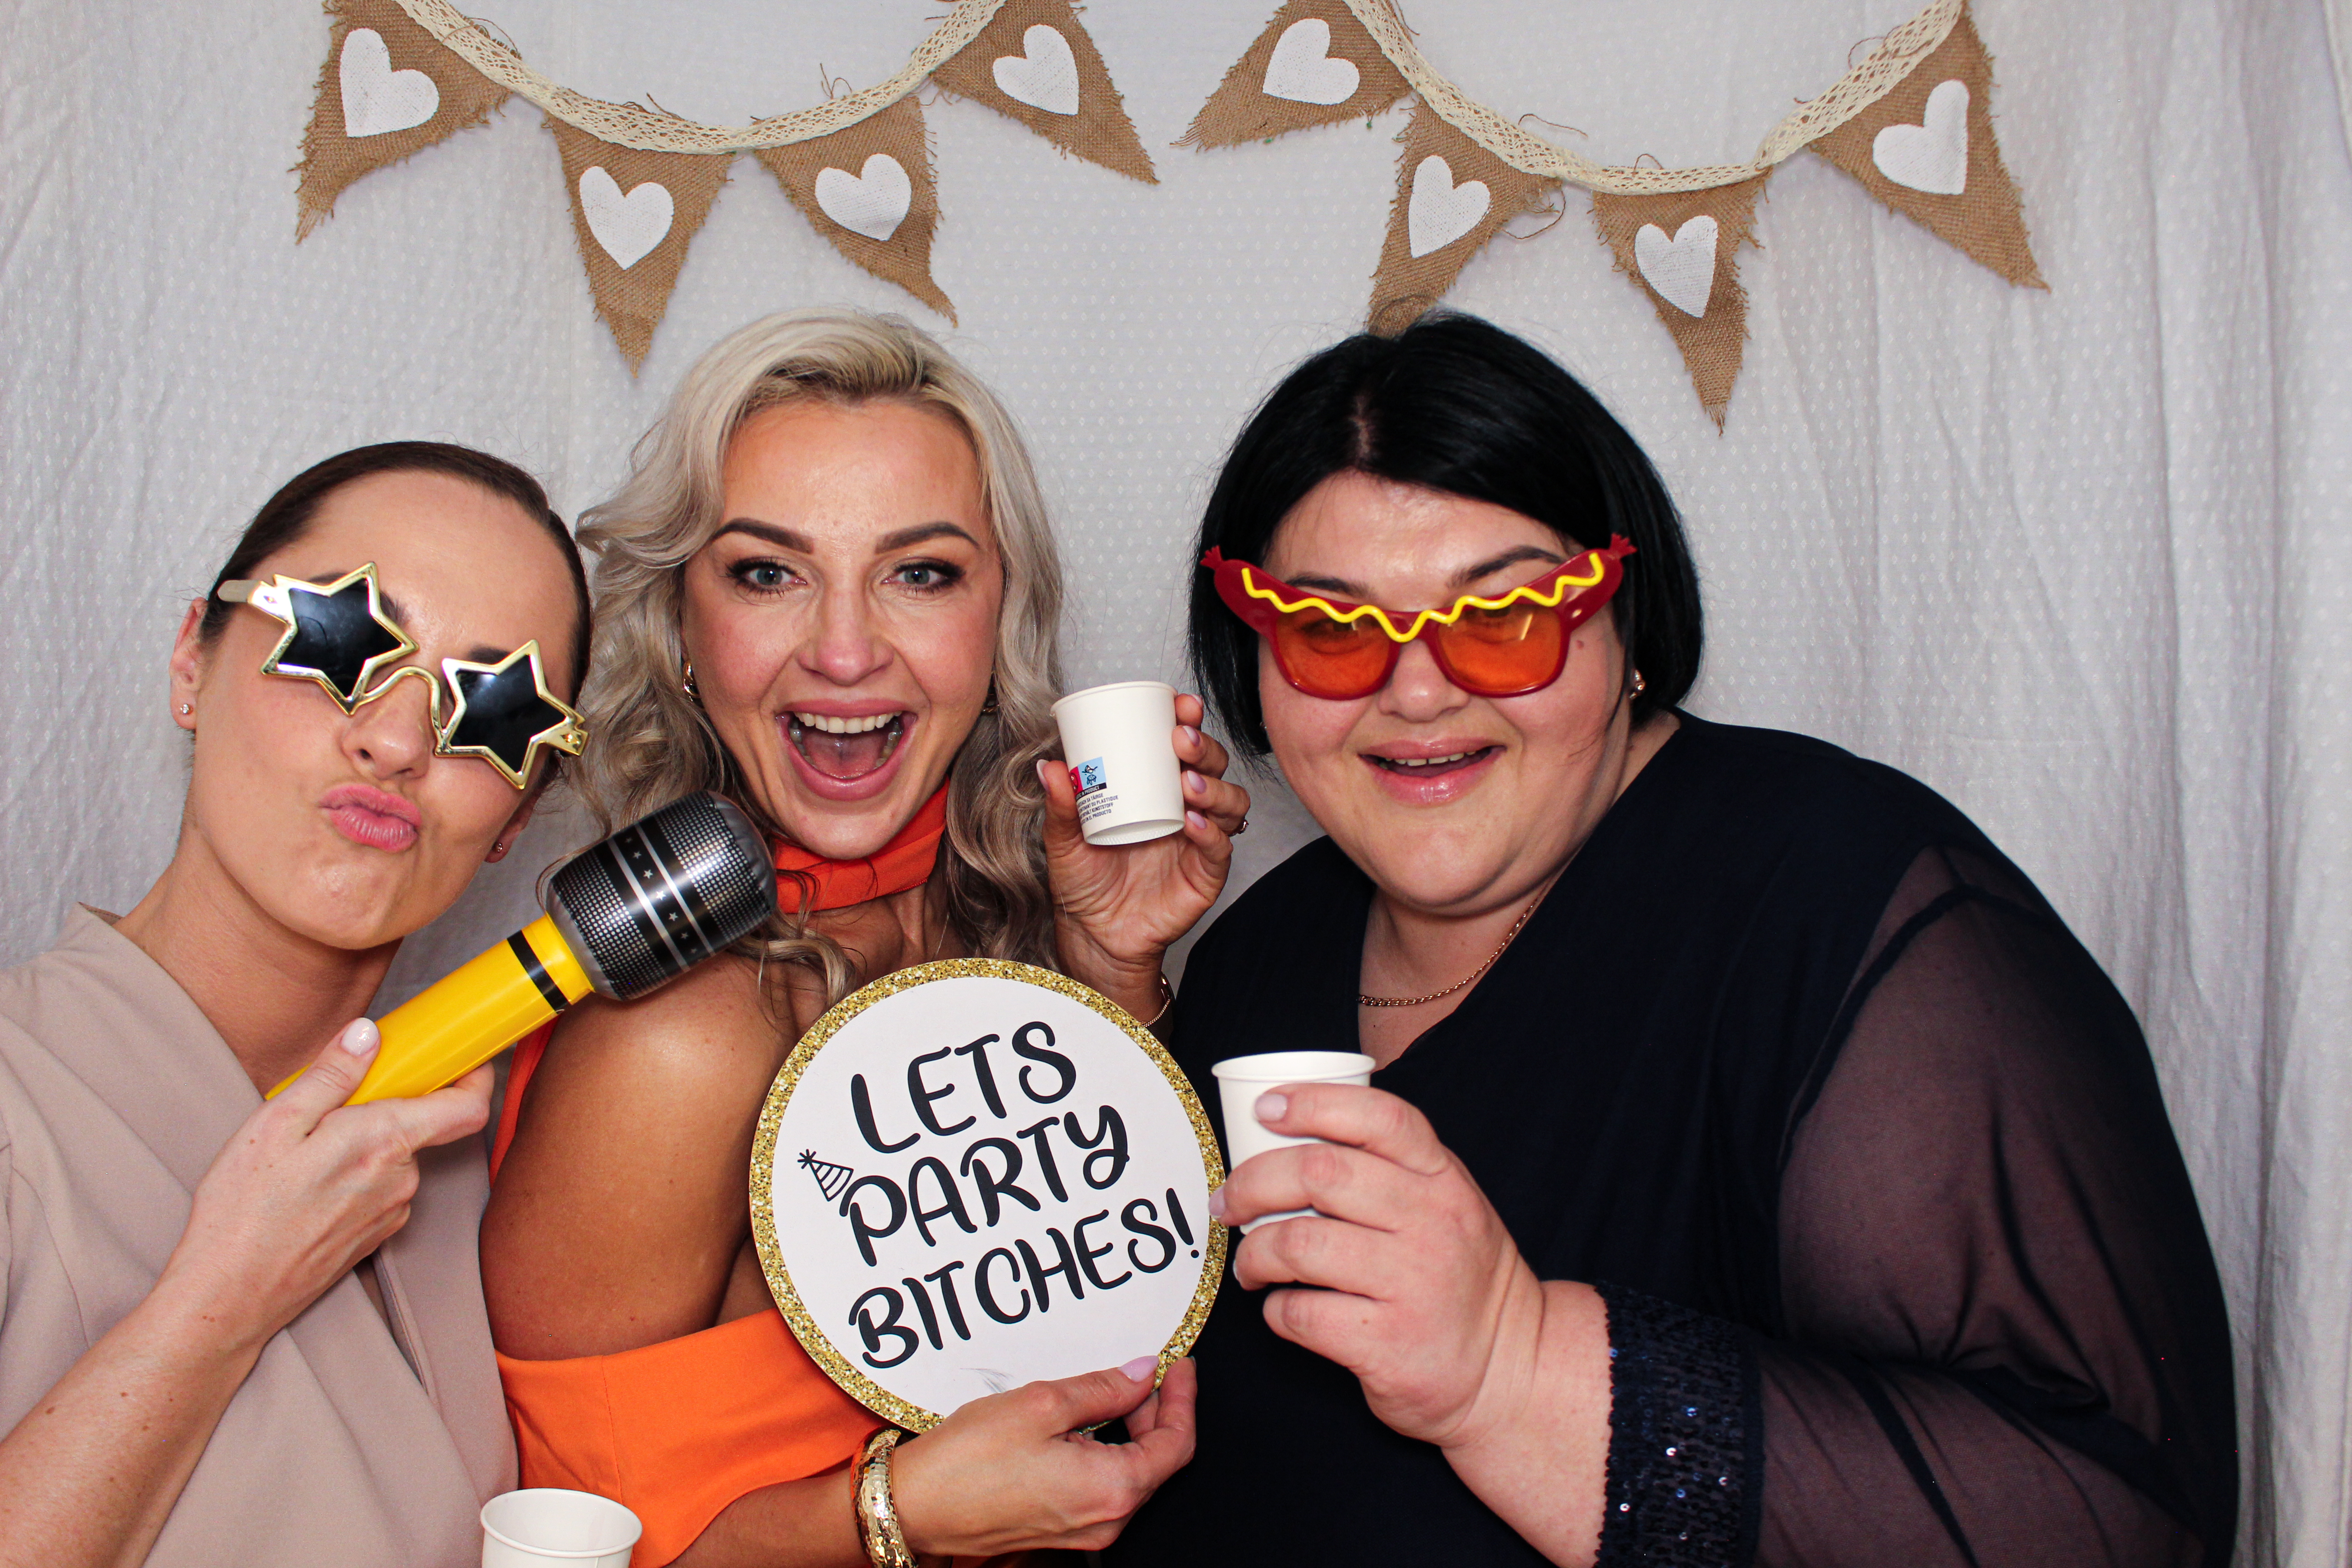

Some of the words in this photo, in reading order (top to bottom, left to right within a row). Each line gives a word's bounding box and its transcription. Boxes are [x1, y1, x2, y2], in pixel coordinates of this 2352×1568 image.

[1084, 785, 1099, 794] PRODUCT
[1097, 795, 1119, 805] PLASTIQUE
[1092, 802, 1113, 813] KUNSTSTOFF
[1093, 809, 1112, 818] PRODUCTO
[851, 1022, 1076, 1153] LETS
[839, 1105, 1130, 1266] PARTY
[849, 1188, 1199, 1368] BITCHES!
